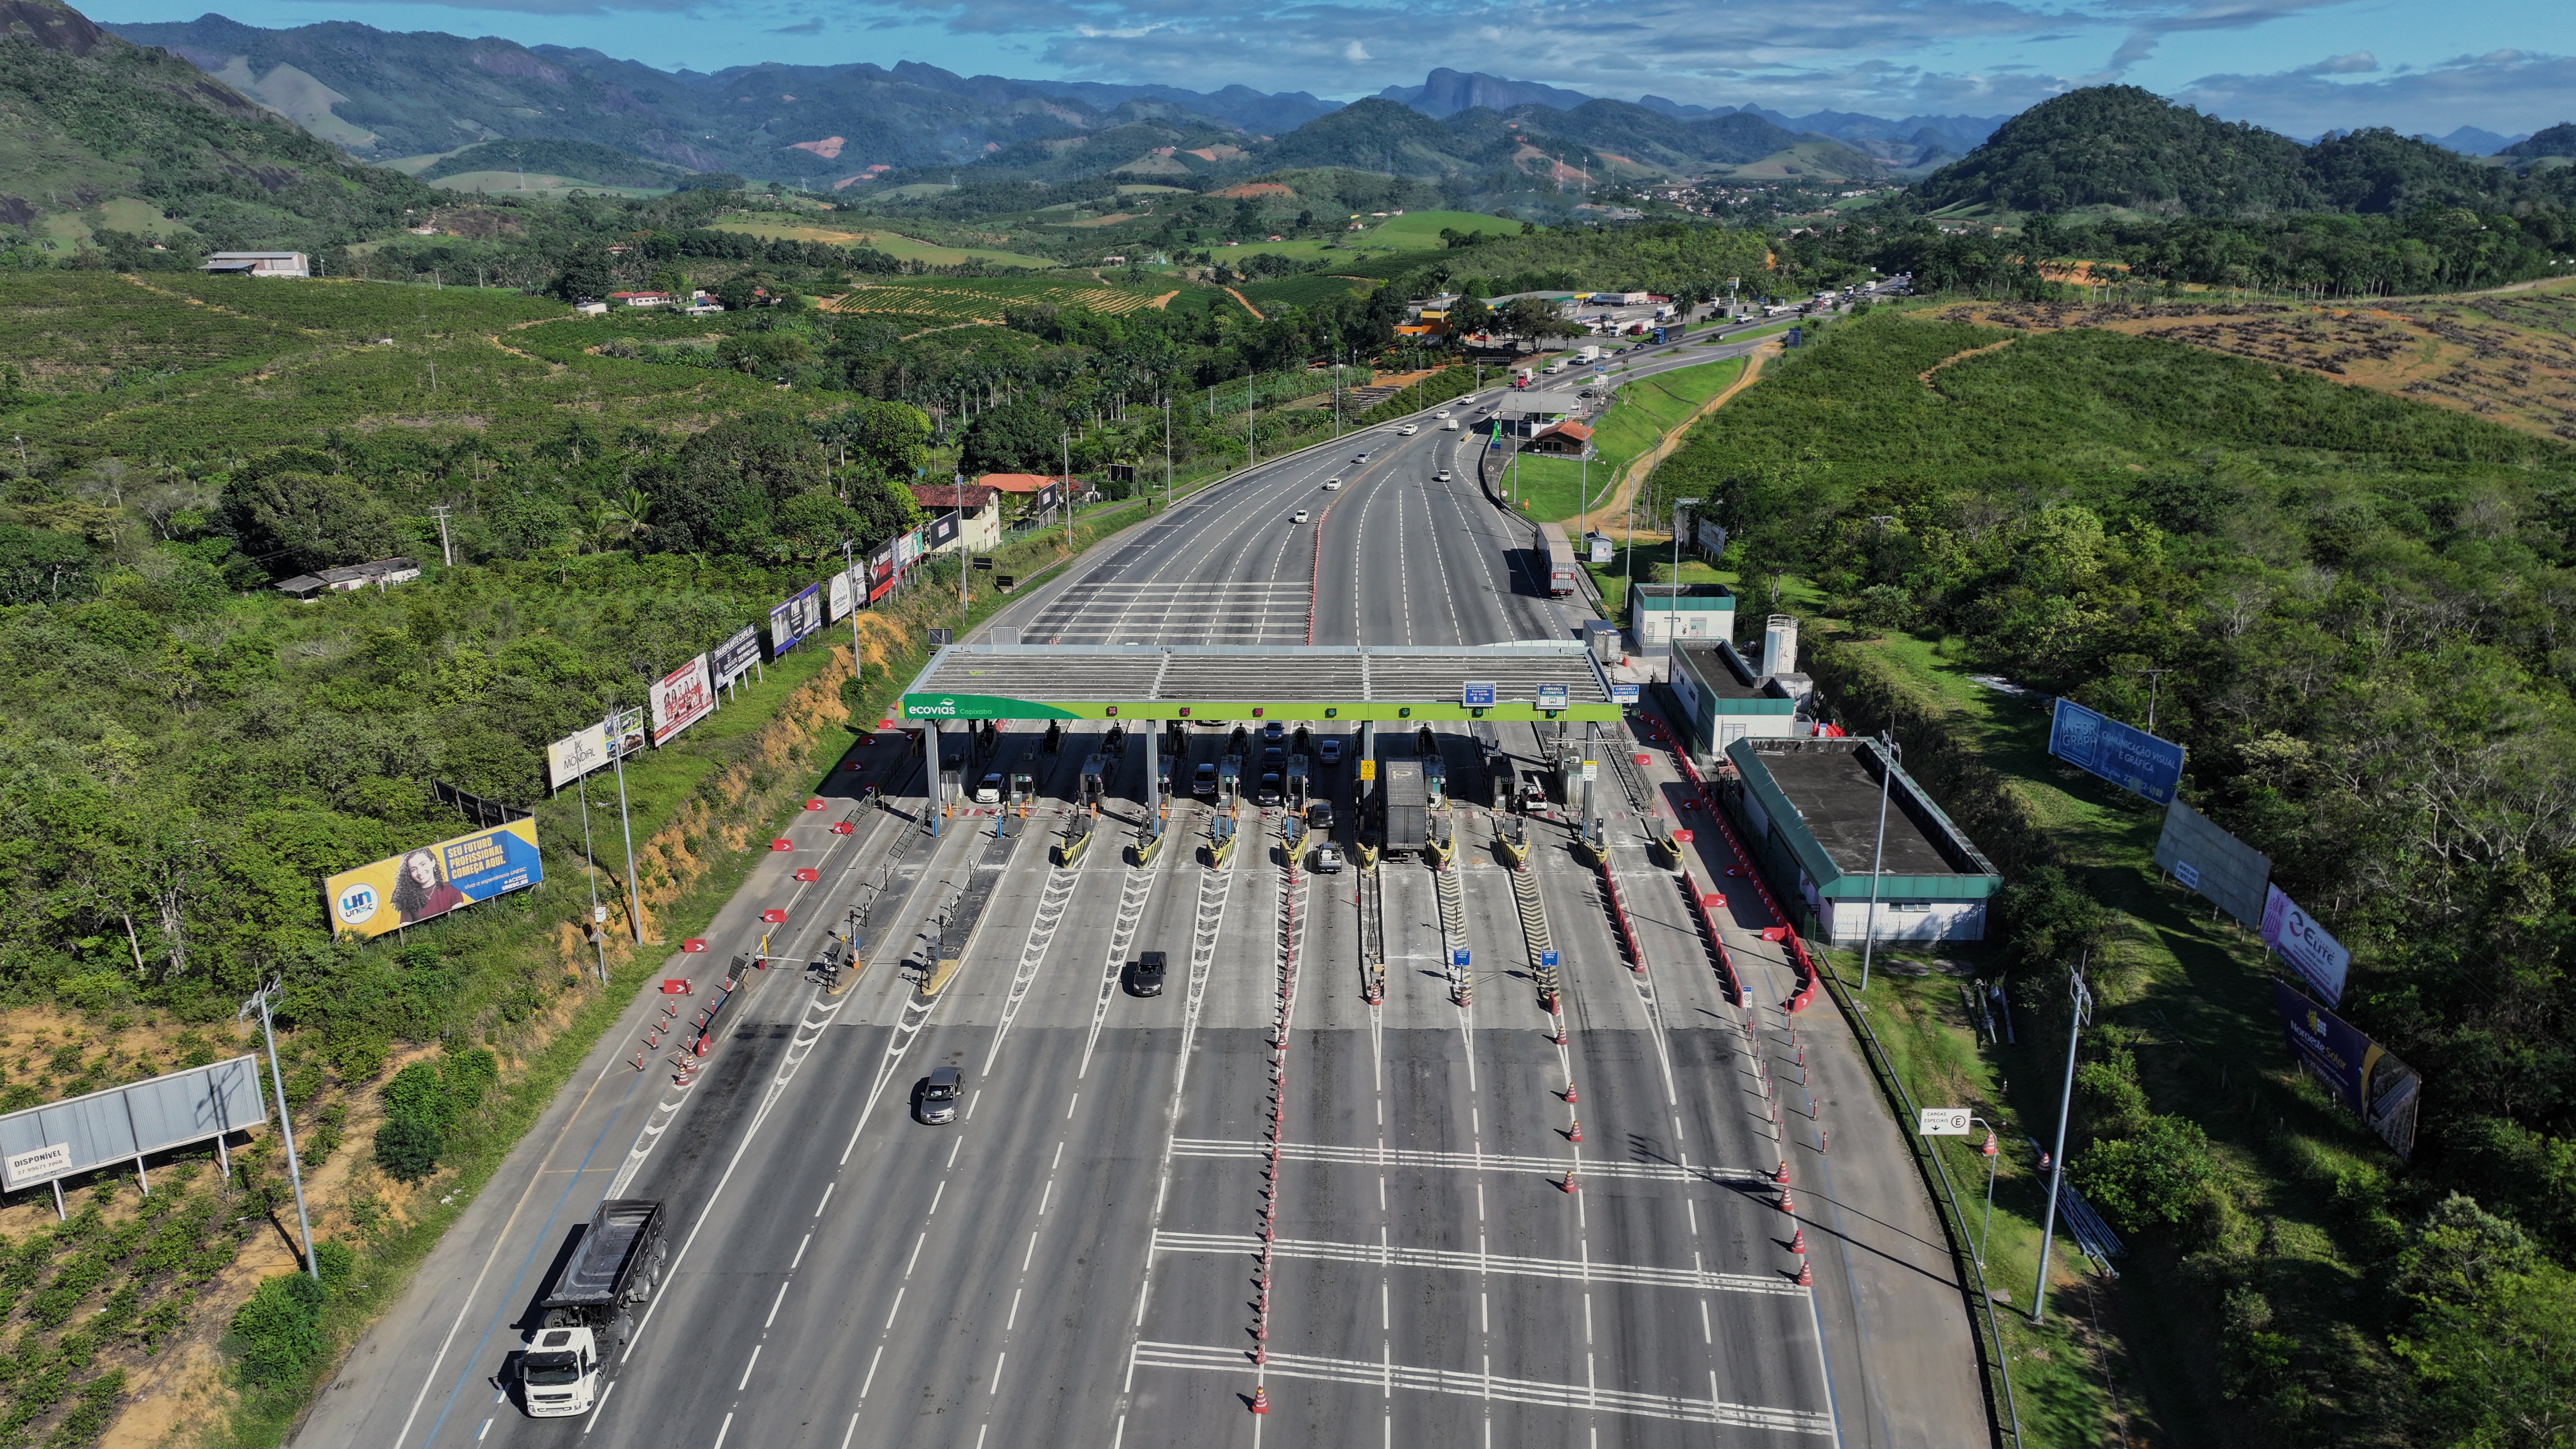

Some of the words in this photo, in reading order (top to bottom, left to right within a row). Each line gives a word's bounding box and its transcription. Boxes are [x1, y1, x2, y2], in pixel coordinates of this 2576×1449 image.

[714, 635, 739, 659] TRANSPLANTE
[738, 625, 754, 642] CAPILAR
[684, 664, 695, 674] ESFA
[908, 706, 956, 715] ecovias
[2062, 722, 2099, 736] INFOR
[2063, 735, 2097, 747] GRAPH
[2102, 730, 2151, 758] COMUNICAÇÃO
[2152, 751, 2177, 769] VISUAL
[564, 747, 596, 770] MONDIAL
[2118, 751, 2123, 759] E
[2124, 753, 2154, 773] GRÁFICA
[447, 845, 463, 858] SEU
[463, 837, 493, 854] FUTURO
[449, 844, 503, 869] PROFISSIONAL
[451, 861, 484, 879] COMEÇA
[485, 855, 506, 869] AQUI.
[481, 872, 509, 885] experiência
[510, 866, 526, 876] UNESC
[508, 873, 527, 884] ACESSE
[345, 904, 373, 917] unesc
[2290, 1019, 2325, 1053] Noroeste
[2326, 1046, 2347, 1070] Solar
[14, 1150, 62, 1167] DISPONÍVEL
